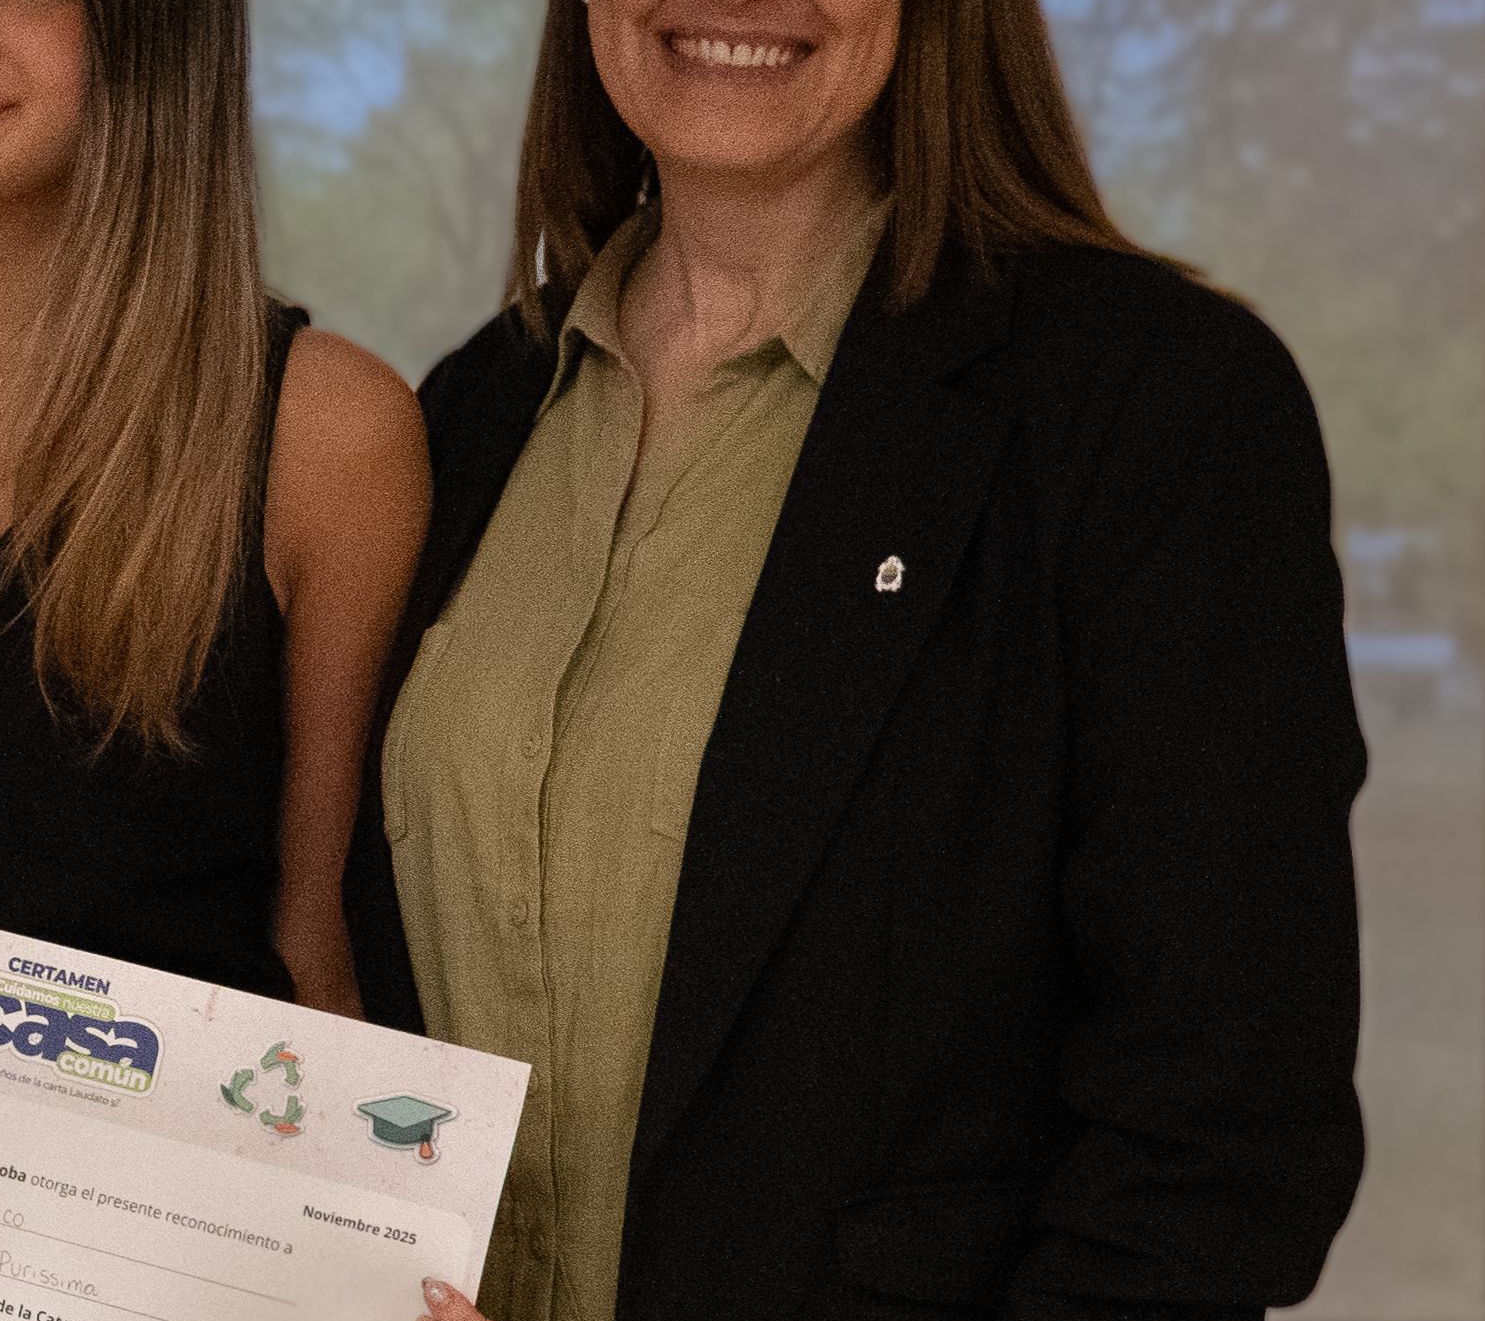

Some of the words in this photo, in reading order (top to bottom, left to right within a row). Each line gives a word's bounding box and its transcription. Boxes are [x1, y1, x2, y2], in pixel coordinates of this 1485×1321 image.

[8, 957, 111, 995] CERTAMEN
[31, 1175, 78, 1199] otorga
[80, 1187, 95, 1201] el
[96, 1192, 163, 1220] presente
[164, 1211, 281, 1252] reconocimiento
[282, 1243, 294, 1256] a
[302, 1205, 381, 1236] Noviembre
[383, 1227, 417, 1246] 2025
